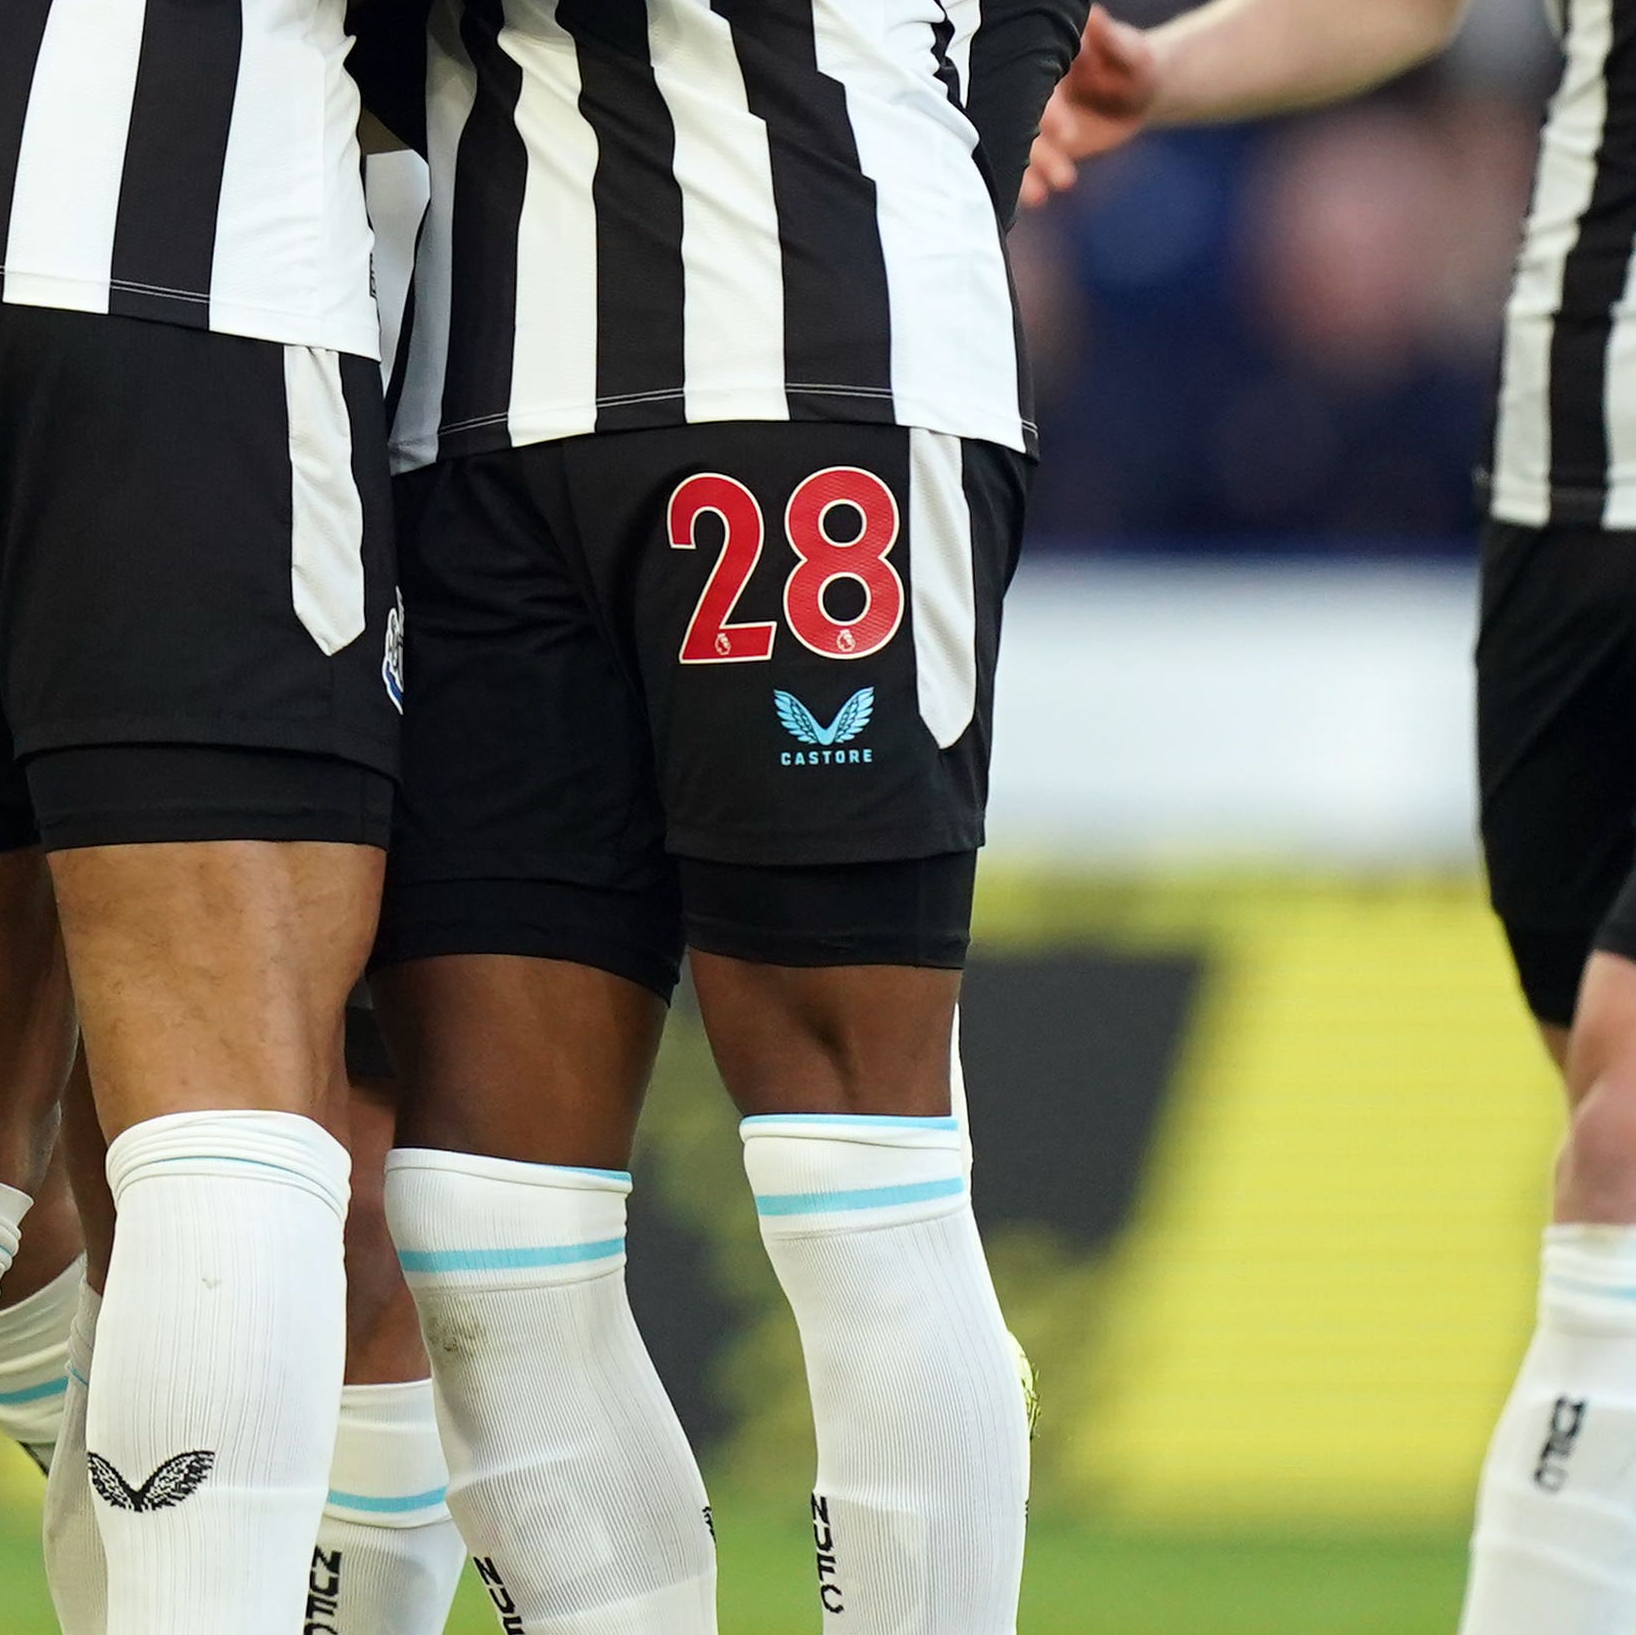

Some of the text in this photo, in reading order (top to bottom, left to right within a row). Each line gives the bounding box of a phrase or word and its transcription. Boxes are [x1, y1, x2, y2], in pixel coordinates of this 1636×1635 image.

[667, 466, 905, 664] 28
[781, 749, 873, 766] CASTORE
[811, 1493, 845, 1615] NUFC
